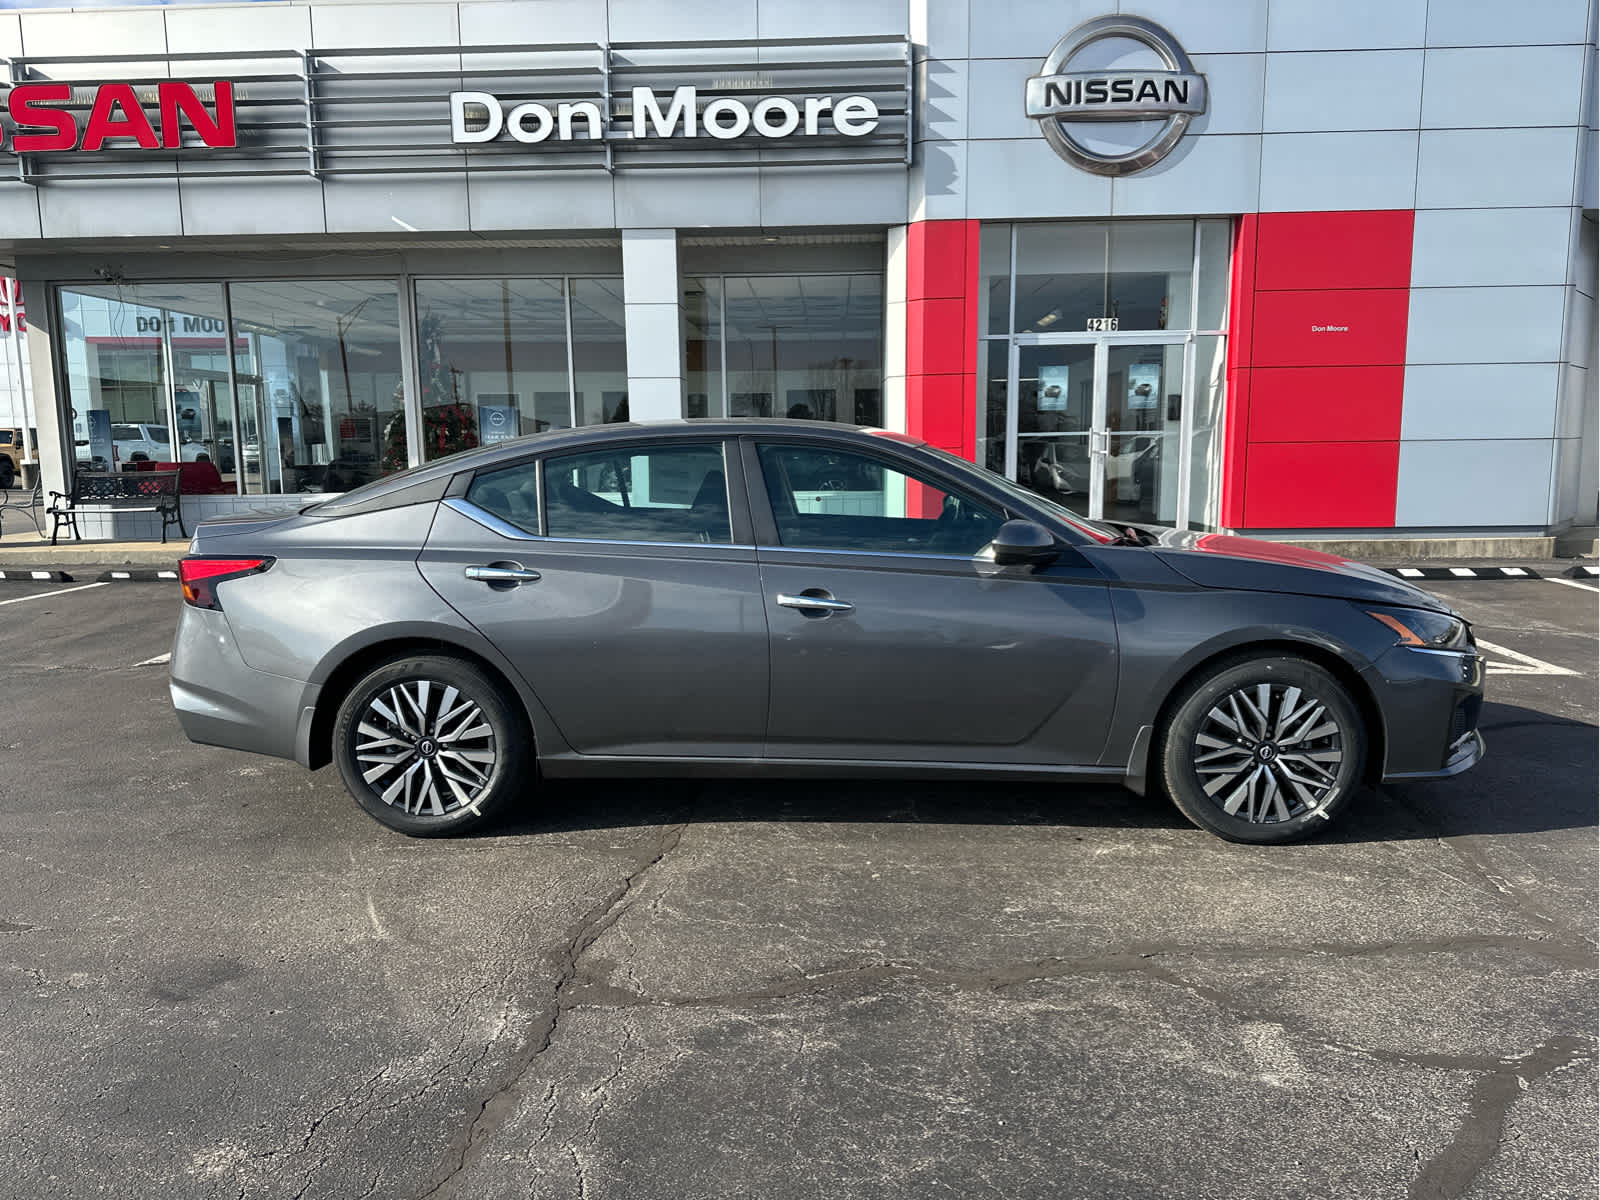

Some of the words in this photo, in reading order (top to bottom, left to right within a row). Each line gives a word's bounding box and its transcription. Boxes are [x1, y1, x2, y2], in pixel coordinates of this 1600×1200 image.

[1045, 79, 1189, 107] NISSAN
[0, 81, 237, 151] SAN
[450, 91, 603, 143] Don
[632, 86, 880, 139] Moore
[1087, 318, 1119, 331] 4216
